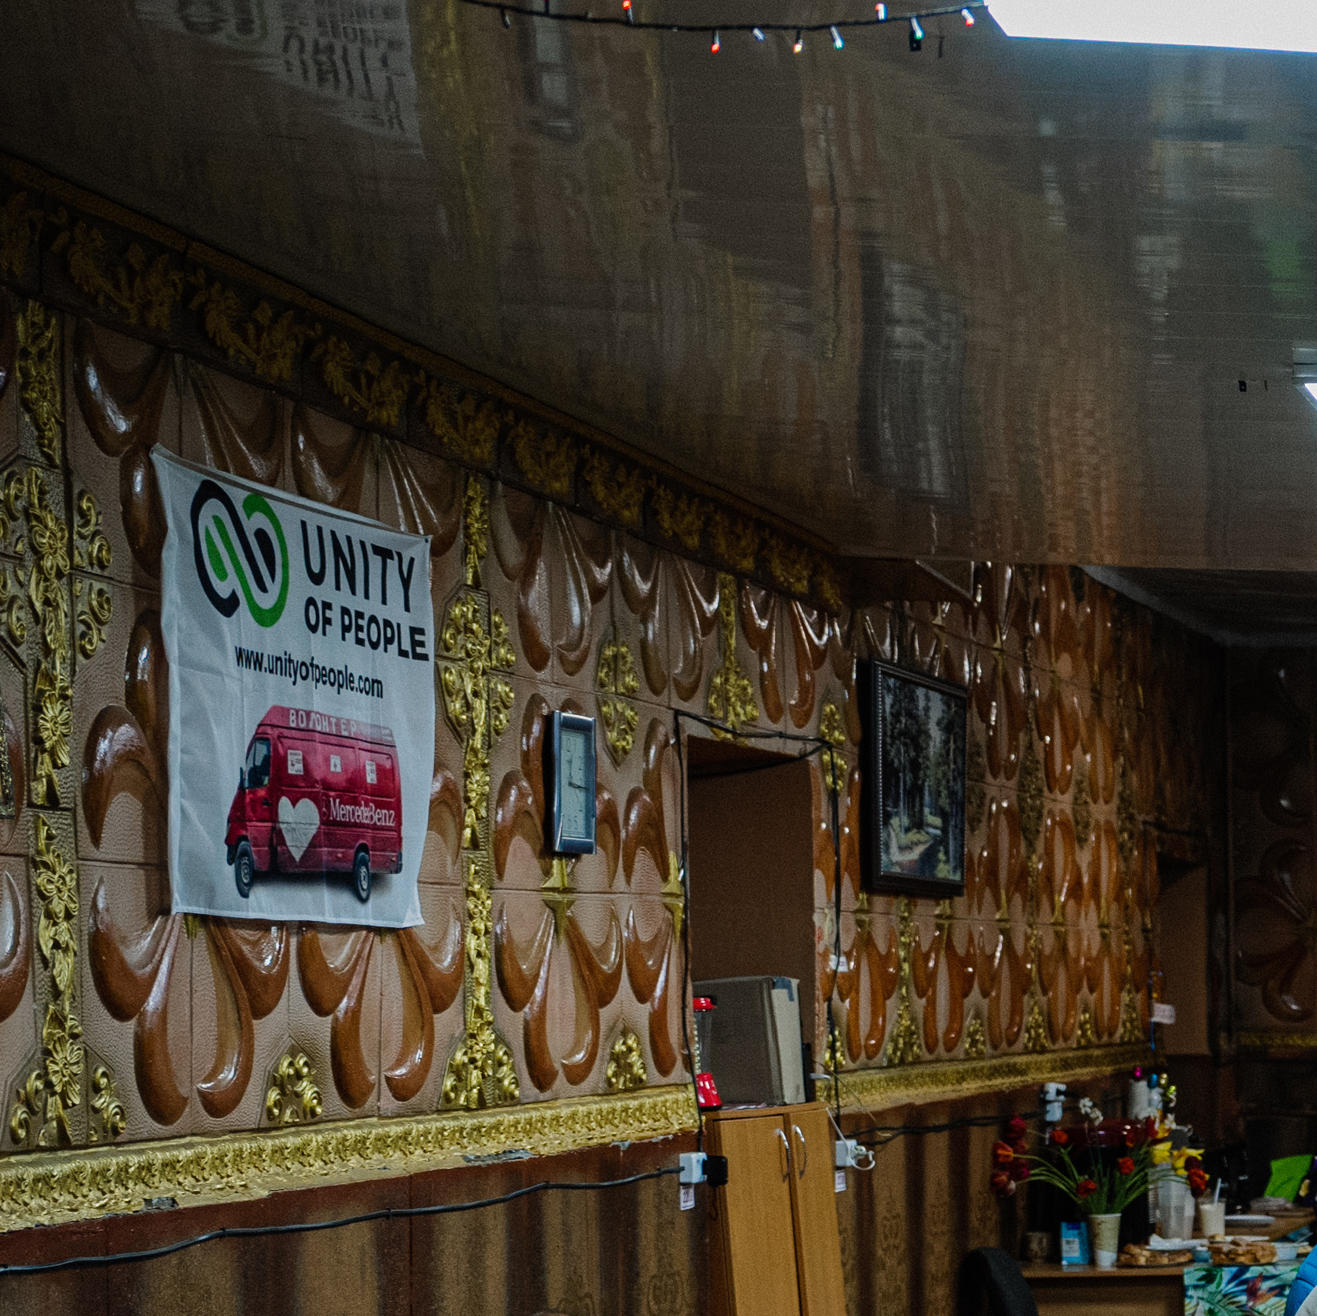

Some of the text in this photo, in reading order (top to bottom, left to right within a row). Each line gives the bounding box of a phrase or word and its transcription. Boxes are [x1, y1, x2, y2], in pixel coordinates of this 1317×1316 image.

[301, 519, 415, 613] UNITY
[304, 596, 430, 662] OF PEOPLE
[235, 646, 384, 699] www.unityofpeople.com
